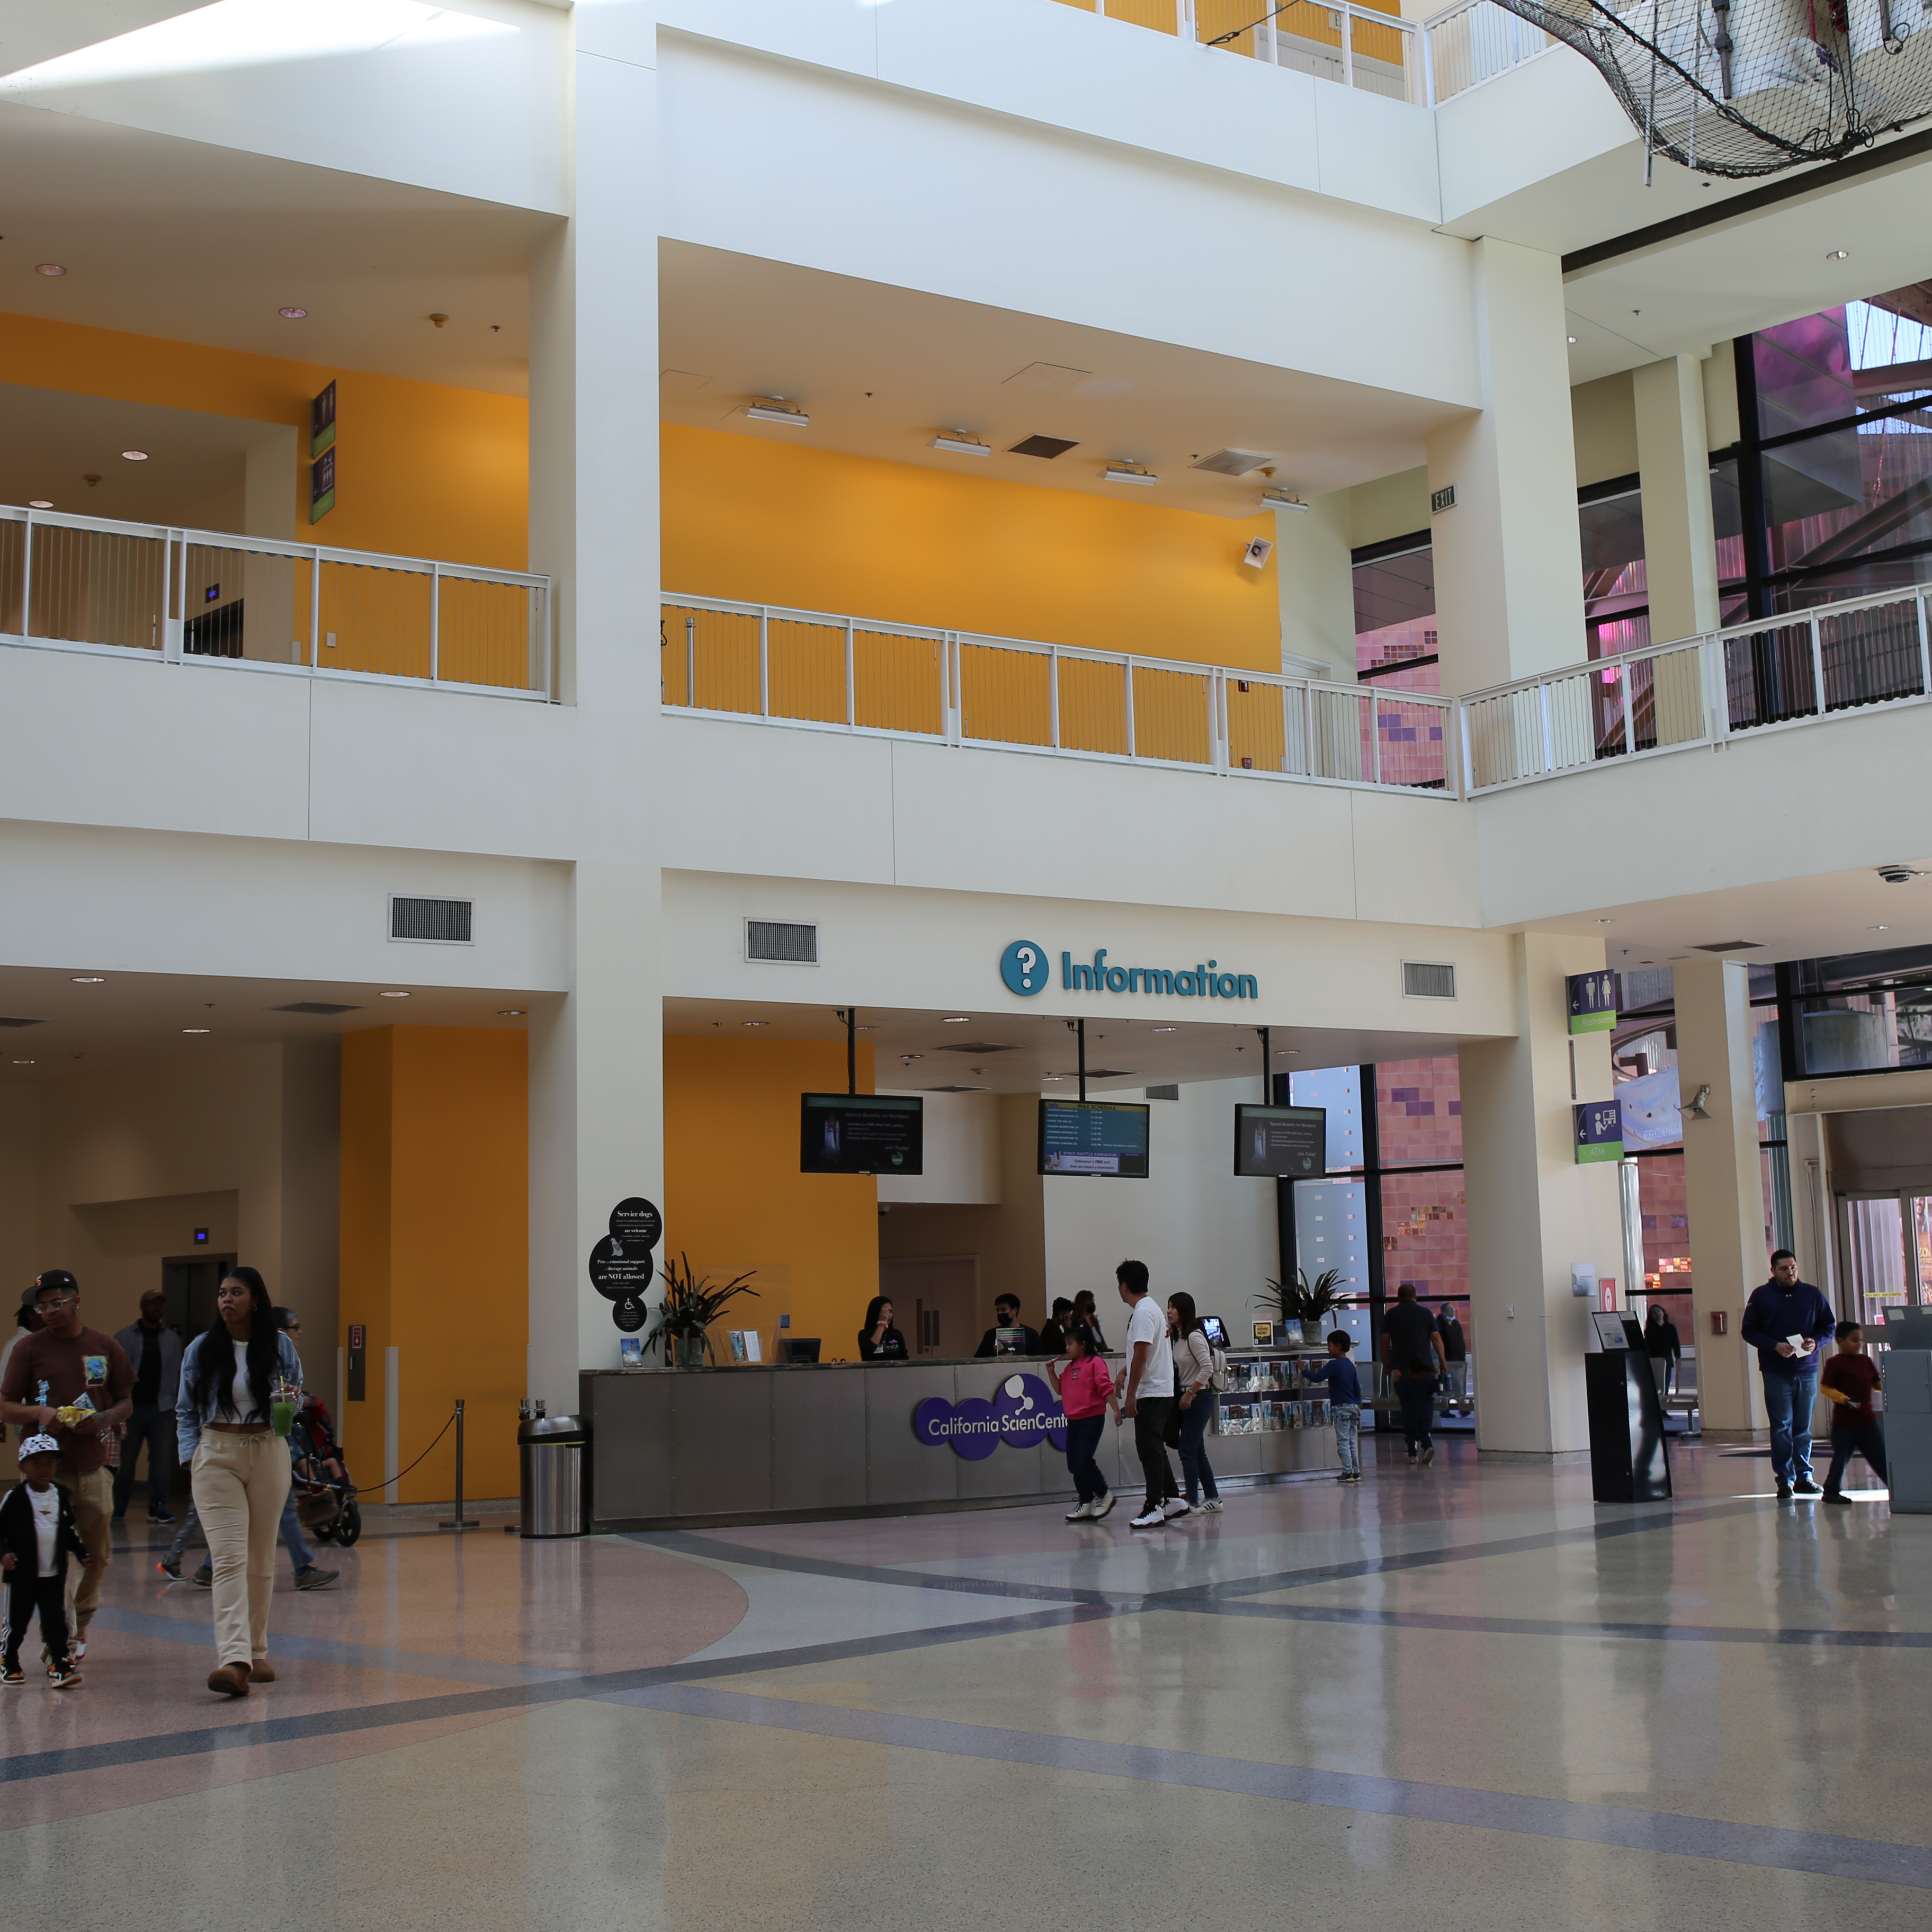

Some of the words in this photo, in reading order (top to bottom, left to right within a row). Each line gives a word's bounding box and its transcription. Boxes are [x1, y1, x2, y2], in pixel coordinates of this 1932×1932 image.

[1435, 488, 1452, 509] EXIT
[1062, 949, 1258, 999] Information
[1582, 1016, 1614, 1026] Restrooms
[1590, 1147, 1605, 1156] ATM
[35, 1274, 42, 1286] S
[928, 1416, 999, 1436] California
